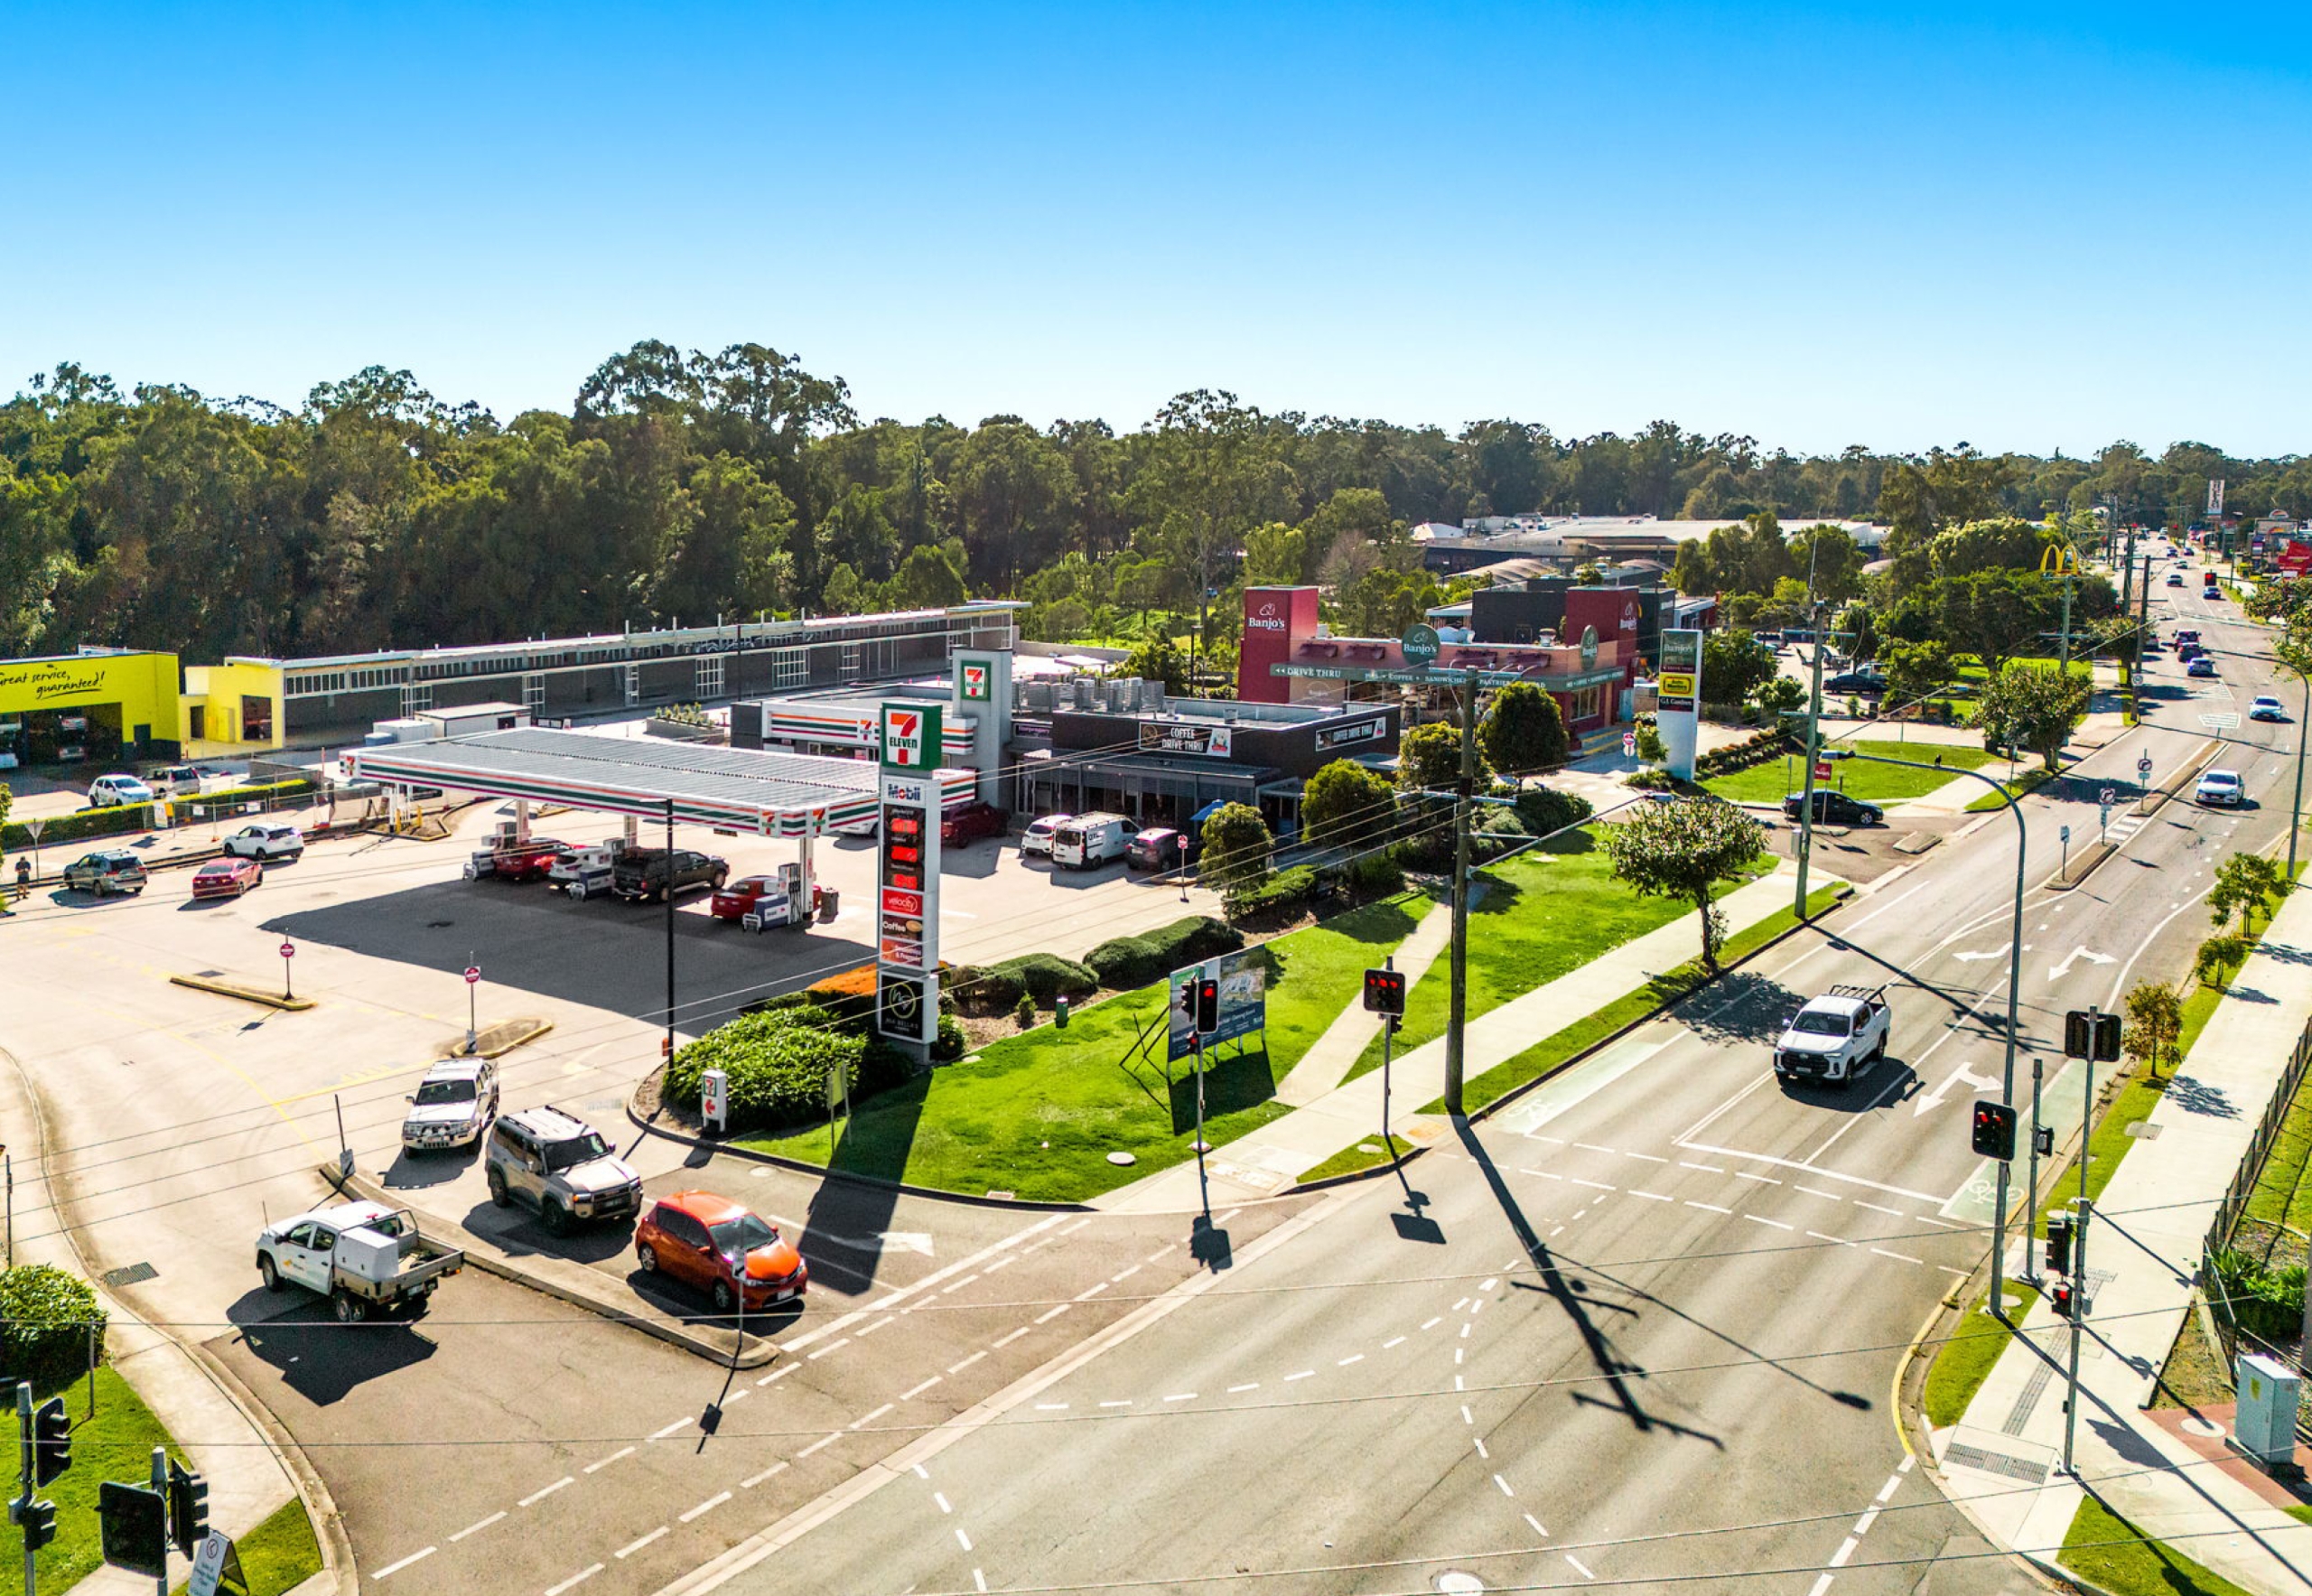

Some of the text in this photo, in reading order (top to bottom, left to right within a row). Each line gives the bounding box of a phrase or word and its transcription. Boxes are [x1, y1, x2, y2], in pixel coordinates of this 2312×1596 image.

[1248, 617, 1285, 630] Banjo's
[1403, 643, 1438, 656] Banjo's
[1287, 667, 1341, 678] DRIVE THRU
[36, 671, 106, 700] guaranteed!
[890, 712, 918, 765] 7
[1170, 728, 1195, 739] COFFEE
[1161, 739, 1204, 751] DRIVE THRU
[888, 784, 920, 801] Mobil
[882, 920, 907, 932] Coffee
